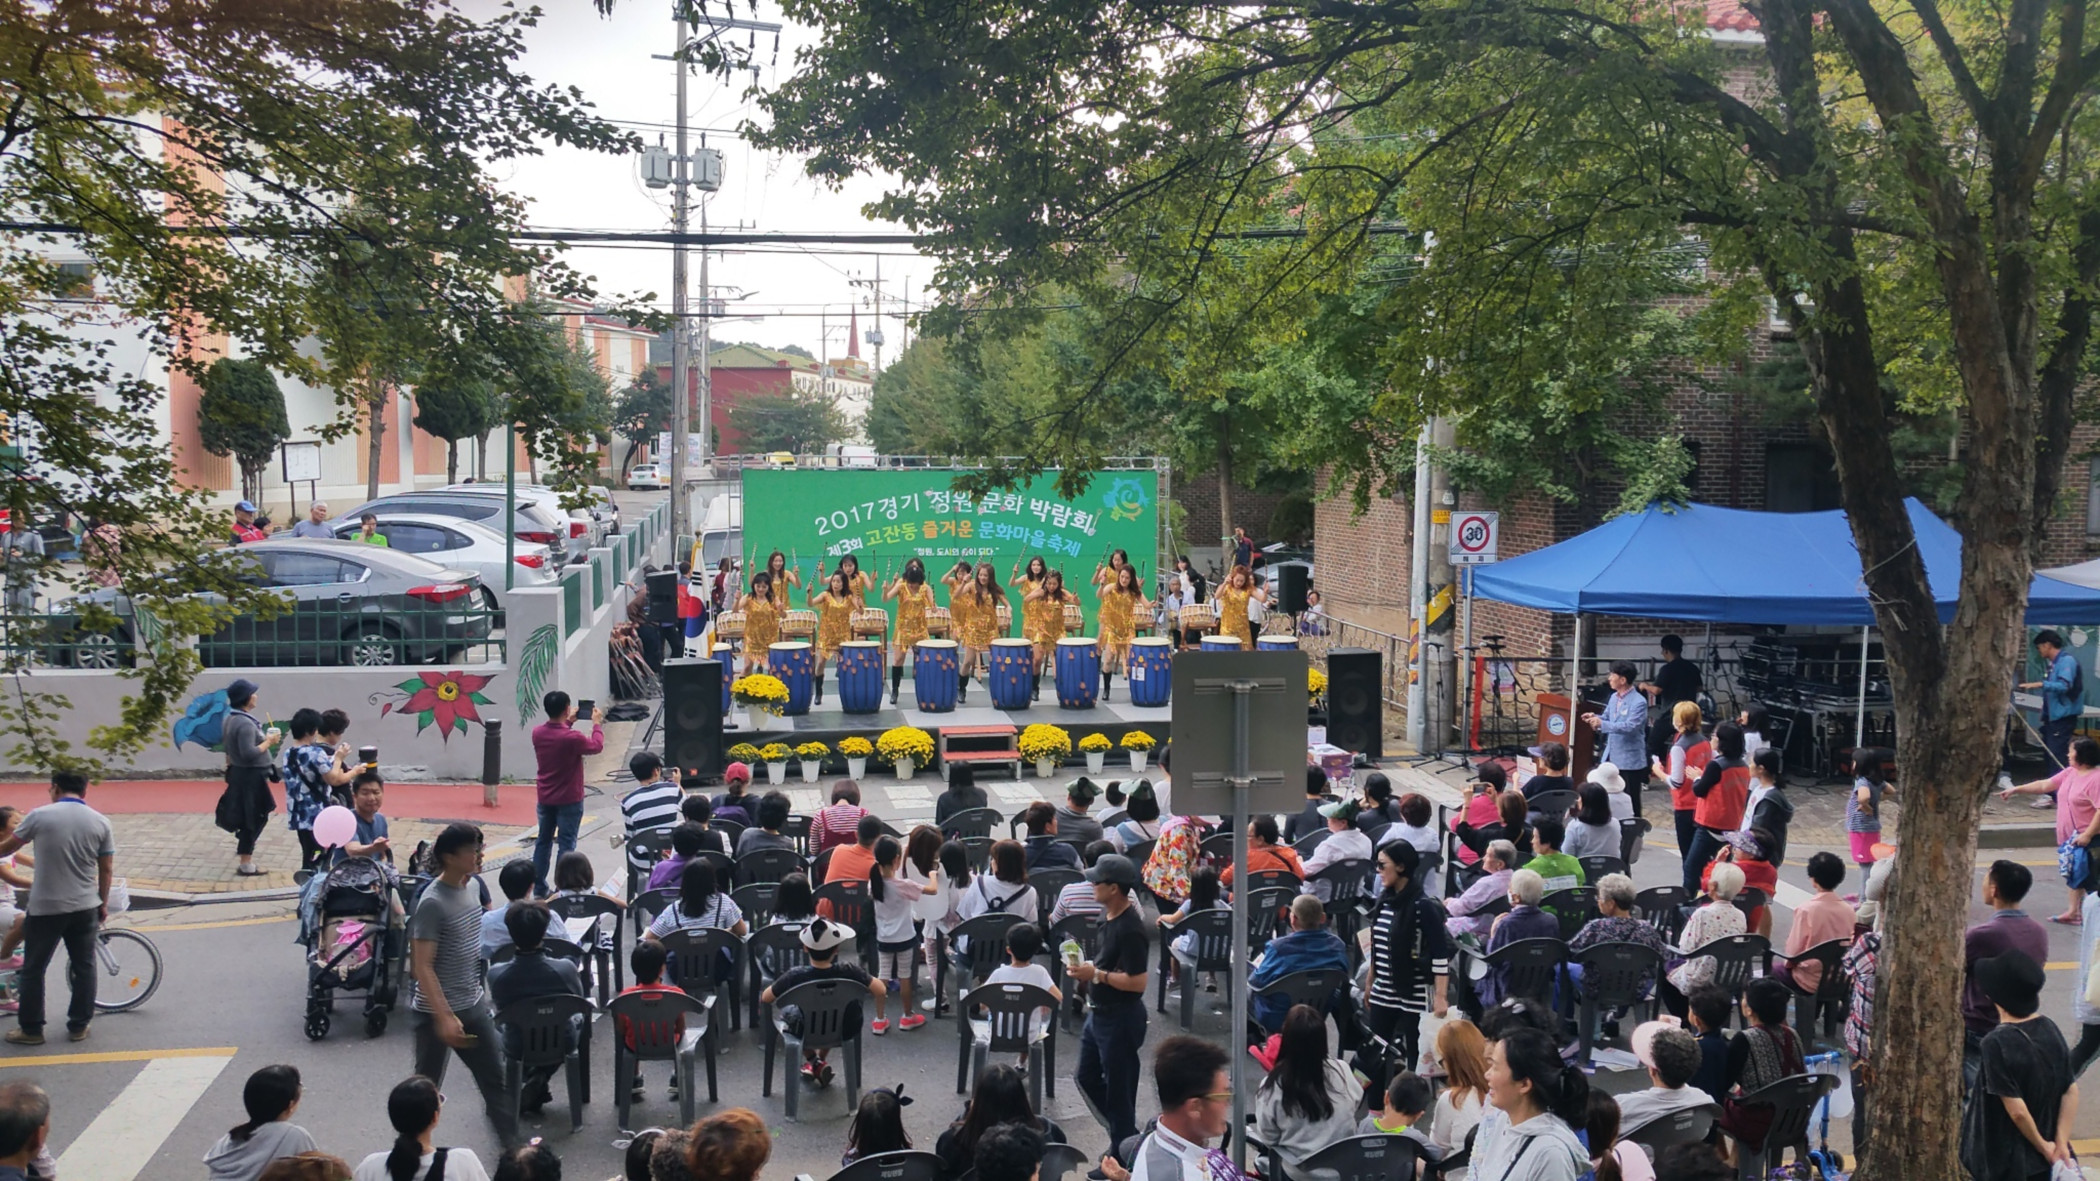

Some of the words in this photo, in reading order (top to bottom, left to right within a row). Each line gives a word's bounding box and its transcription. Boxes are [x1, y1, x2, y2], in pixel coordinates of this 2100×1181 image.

[930, 490, 973, 514] 정원
[980, 492, 1024, 515] 문화
[826, 537, 864, 557] 제3회
[865, 521, 918, 547] 고잔동
[922, 519, 974, 539] 즐거운
[1466, 526, 1483, 541] 30
